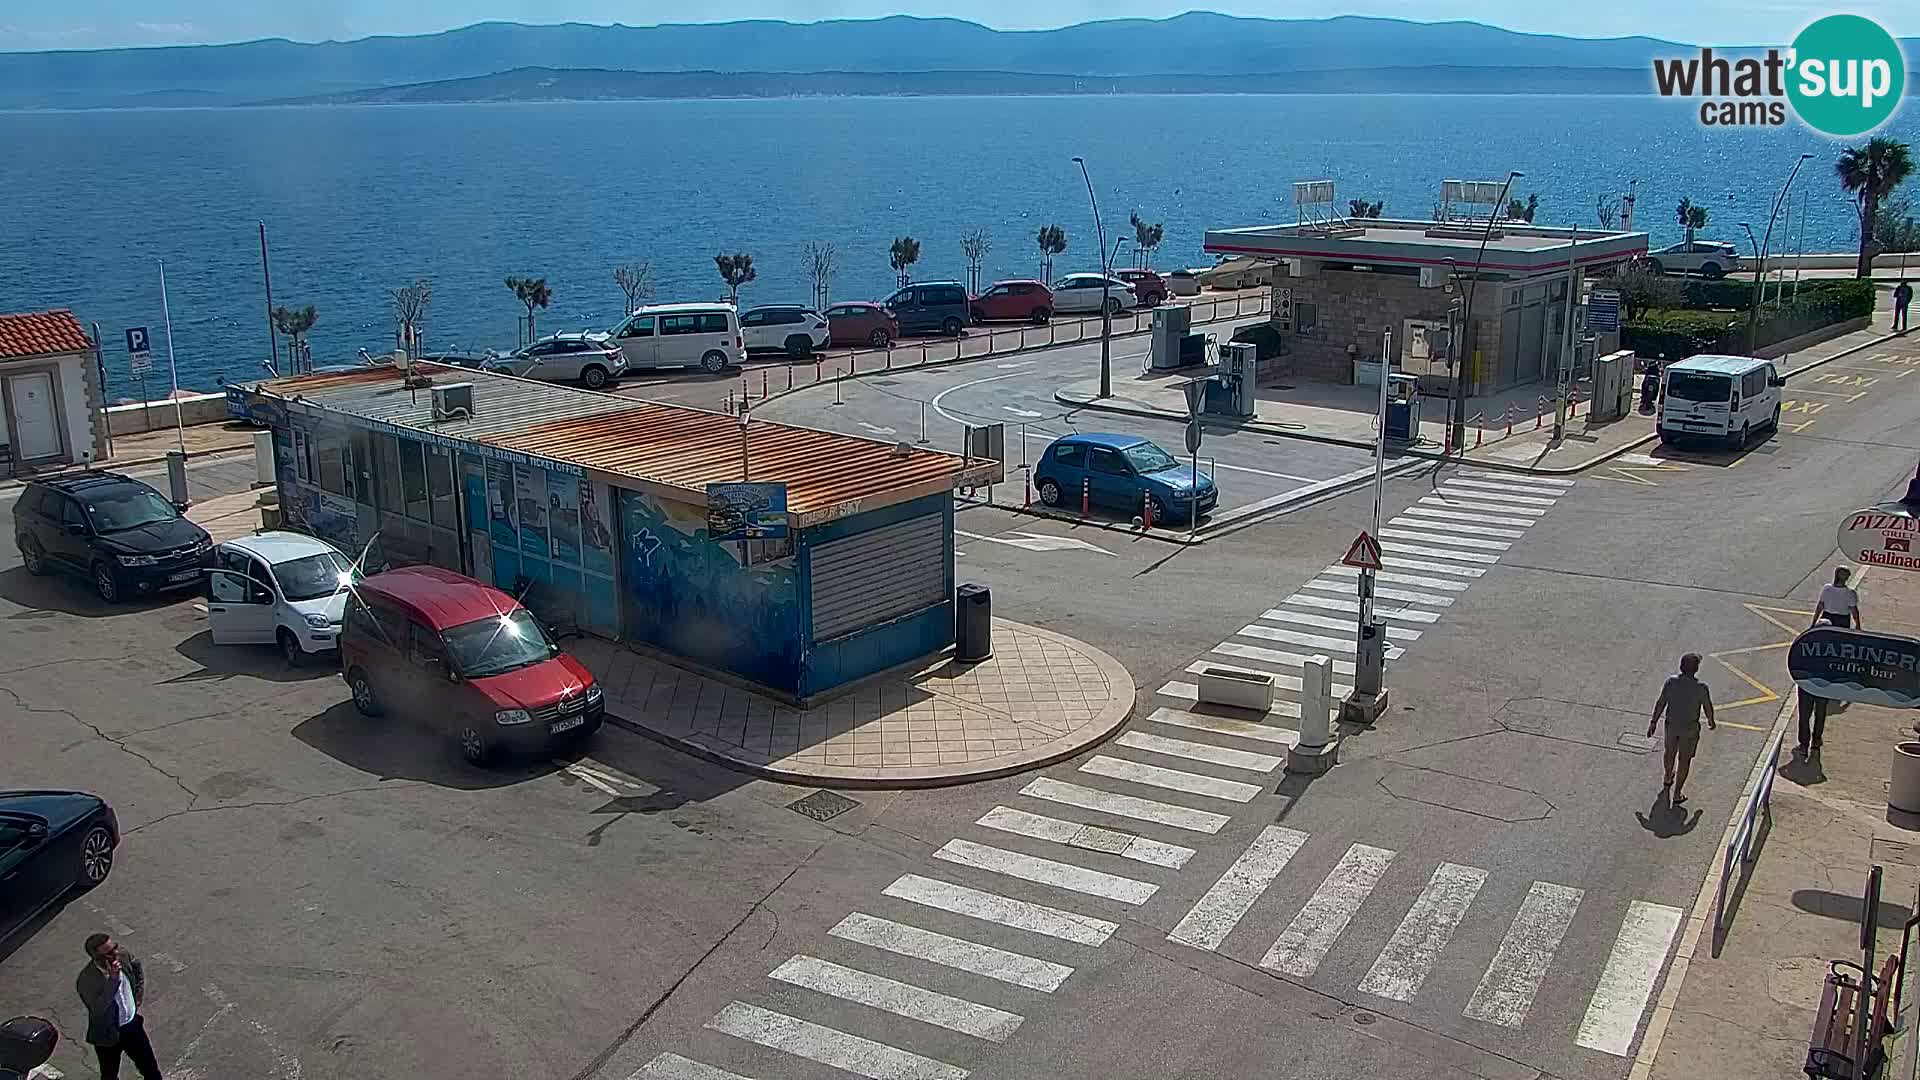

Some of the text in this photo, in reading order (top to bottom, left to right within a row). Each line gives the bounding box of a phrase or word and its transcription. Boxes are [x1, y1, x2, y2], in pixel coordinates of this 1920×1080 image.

[132, 331, 143, 349] P
[1814, 374, 1880, 388] TAXI
[1781, 400, 1830, 414] AXI
[495, 450, 527, 463] STATION
[529, 456, 555, 470] TICKET
[556, 463, 583, 476] OFFICE
[1848, 515, 1920, 533] PIZZE
[1881, 530, 1917, 539] GRILL
[1800, 642, 1920, 672] MARINER
[1828, 662, 1896, 680] caffe bar
